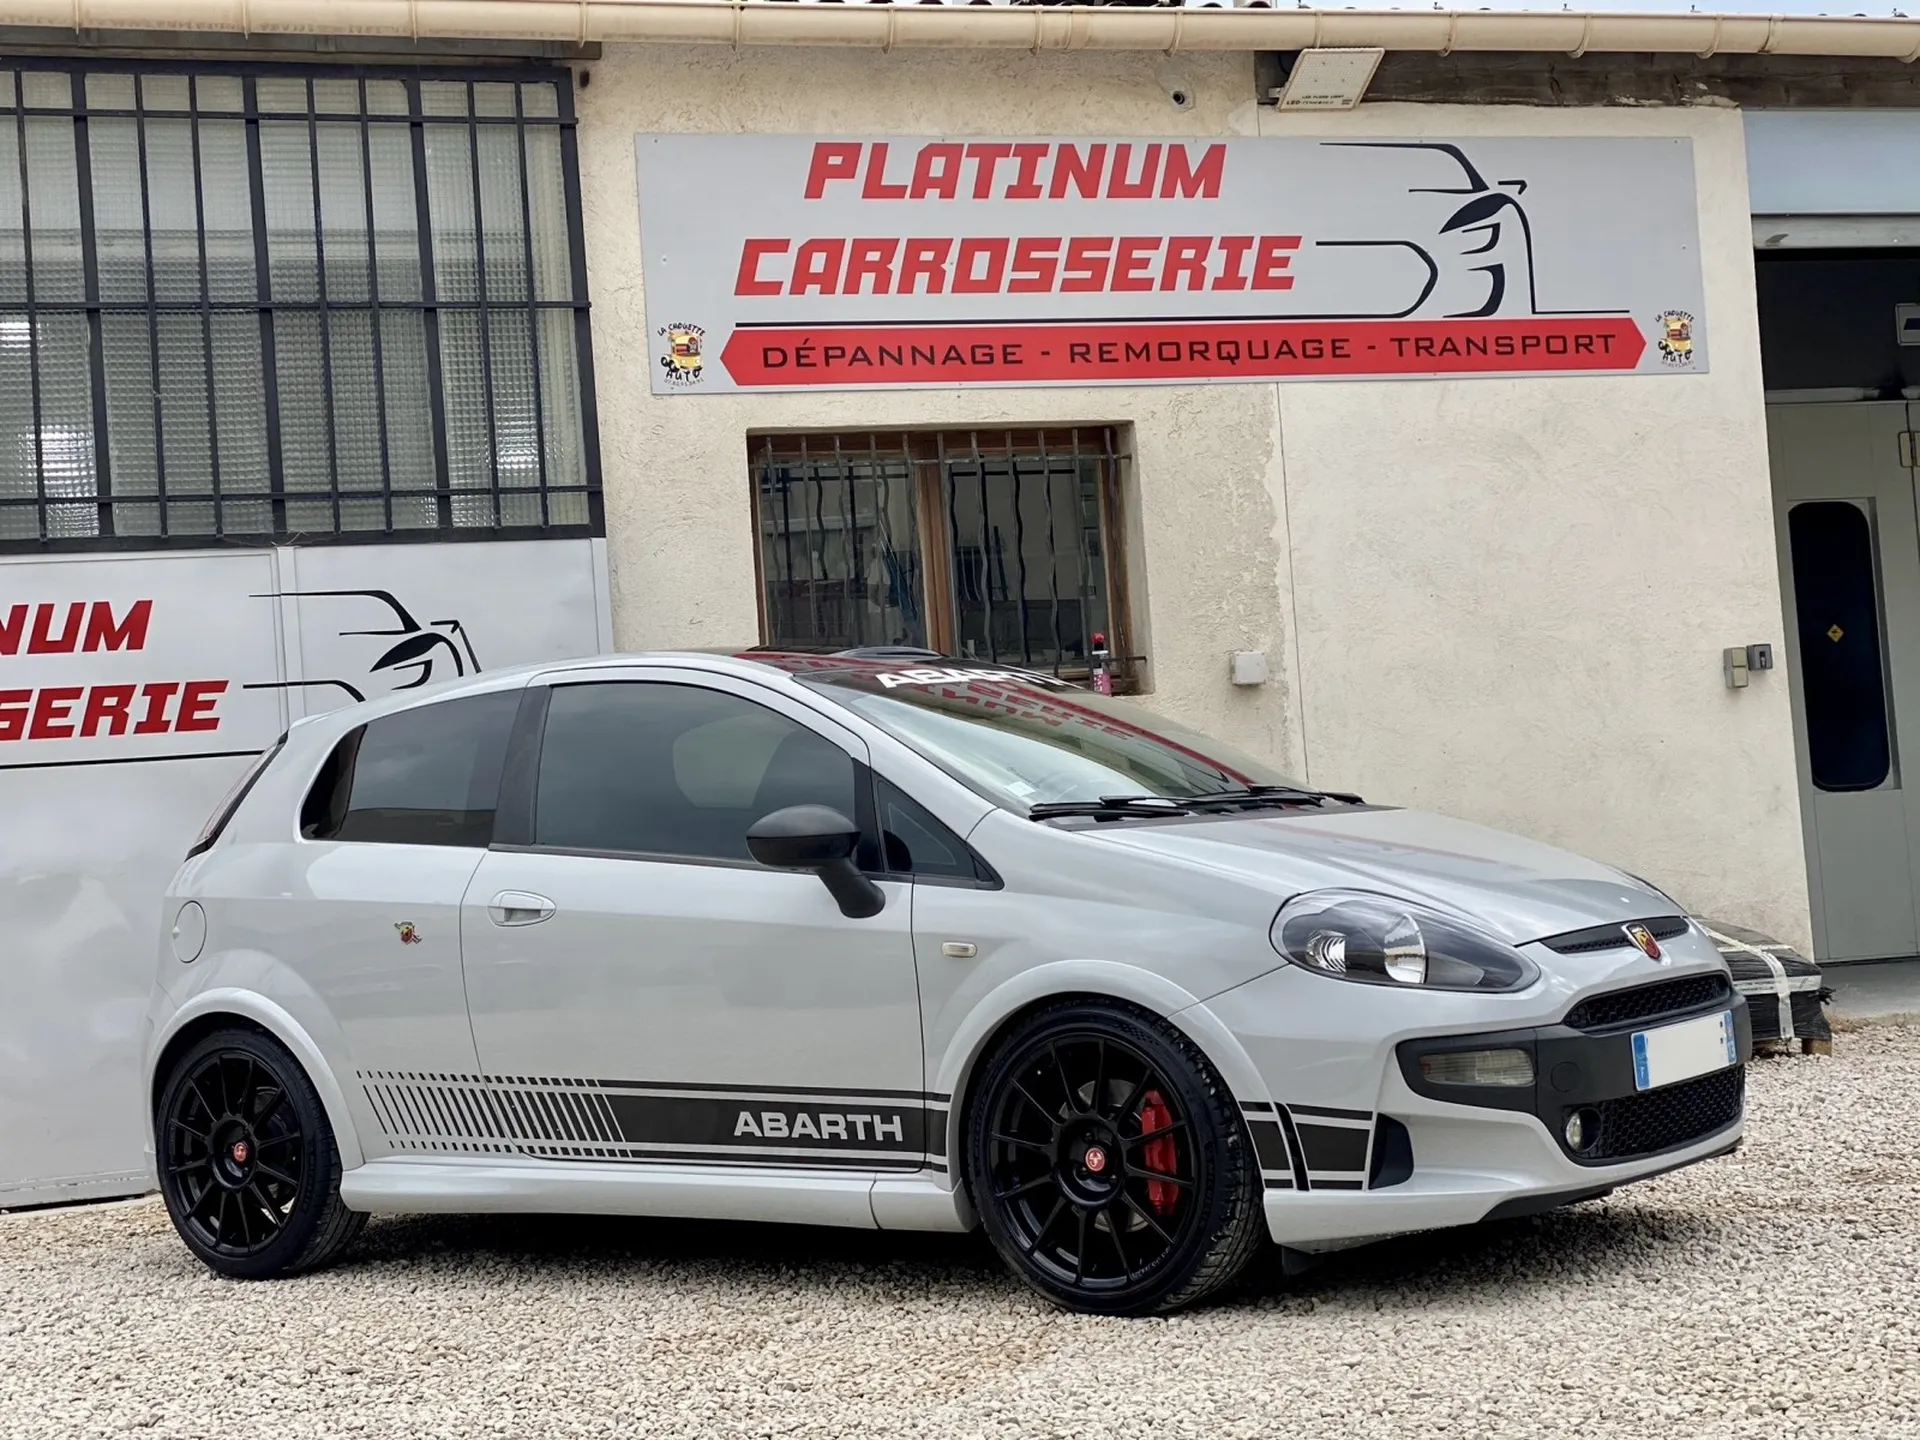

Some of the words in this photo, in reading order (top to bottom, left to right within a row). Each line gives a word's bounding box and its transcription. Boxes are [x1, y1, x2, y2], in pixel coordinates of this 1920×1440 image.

[804, 142, 1227, 199] PLATINUM
[733, 235, 1303, 296] CARROSSERIE
[762, 338, 1024, 369] DÉPANNAGE
[1069, 338, 1352, 365] REMORQUAGE
[1390, 333, 1617, 358] TRANSPORT
[733, 1110, 904, 1142] ABARTH
